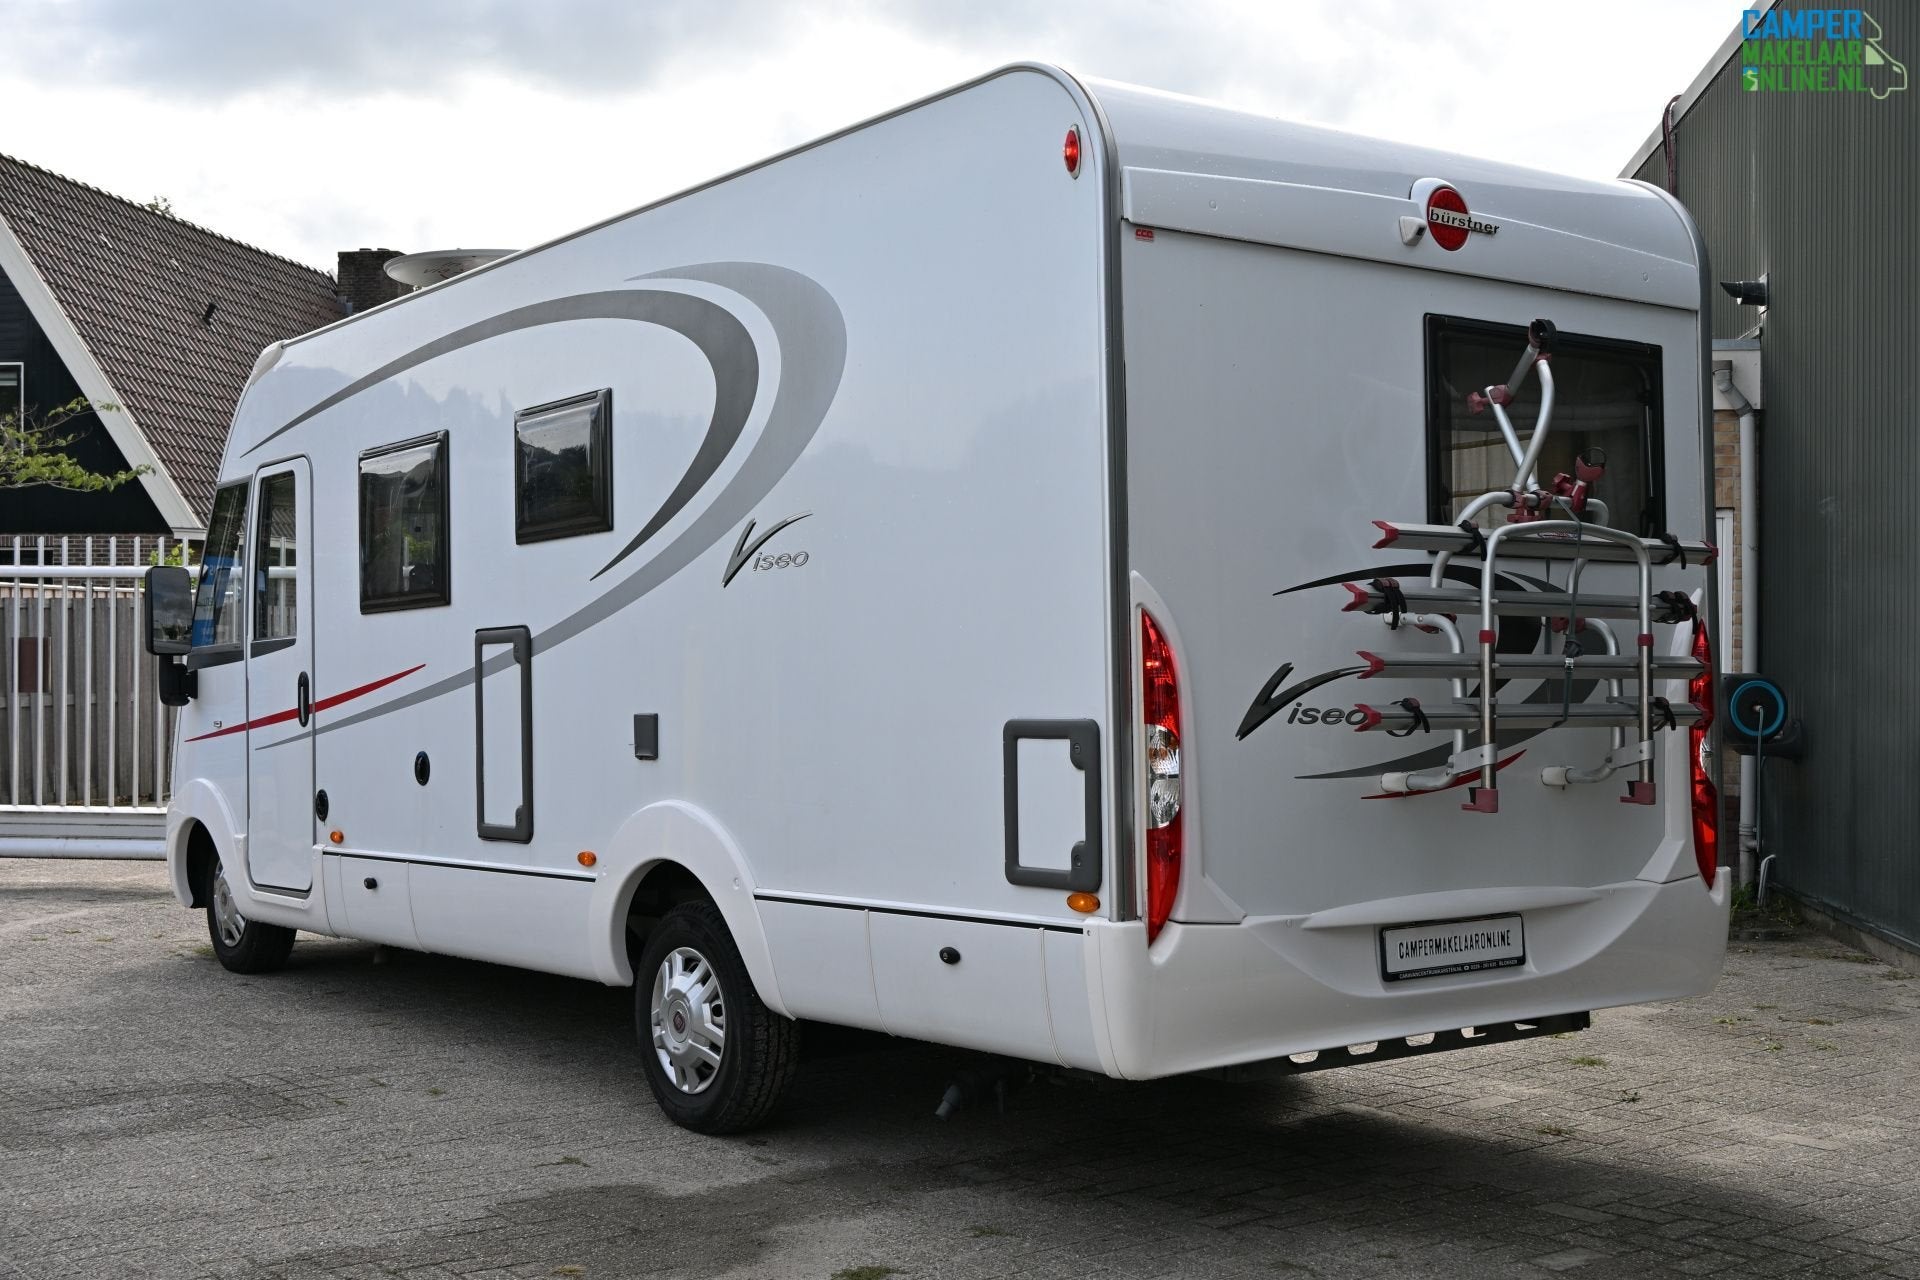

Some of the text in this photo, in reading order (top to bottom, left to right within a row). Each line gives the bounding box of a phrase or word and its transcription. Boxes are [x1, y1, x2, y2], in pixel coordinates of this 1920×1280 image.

[1430, 208, 1500, 234] bürstner
[721, 512, 814, 588] Viseo
[1235, 662, 1371, 741] Viseo
[1398, 929, 1511, 959] CAMPERMAKELAARONLINE
